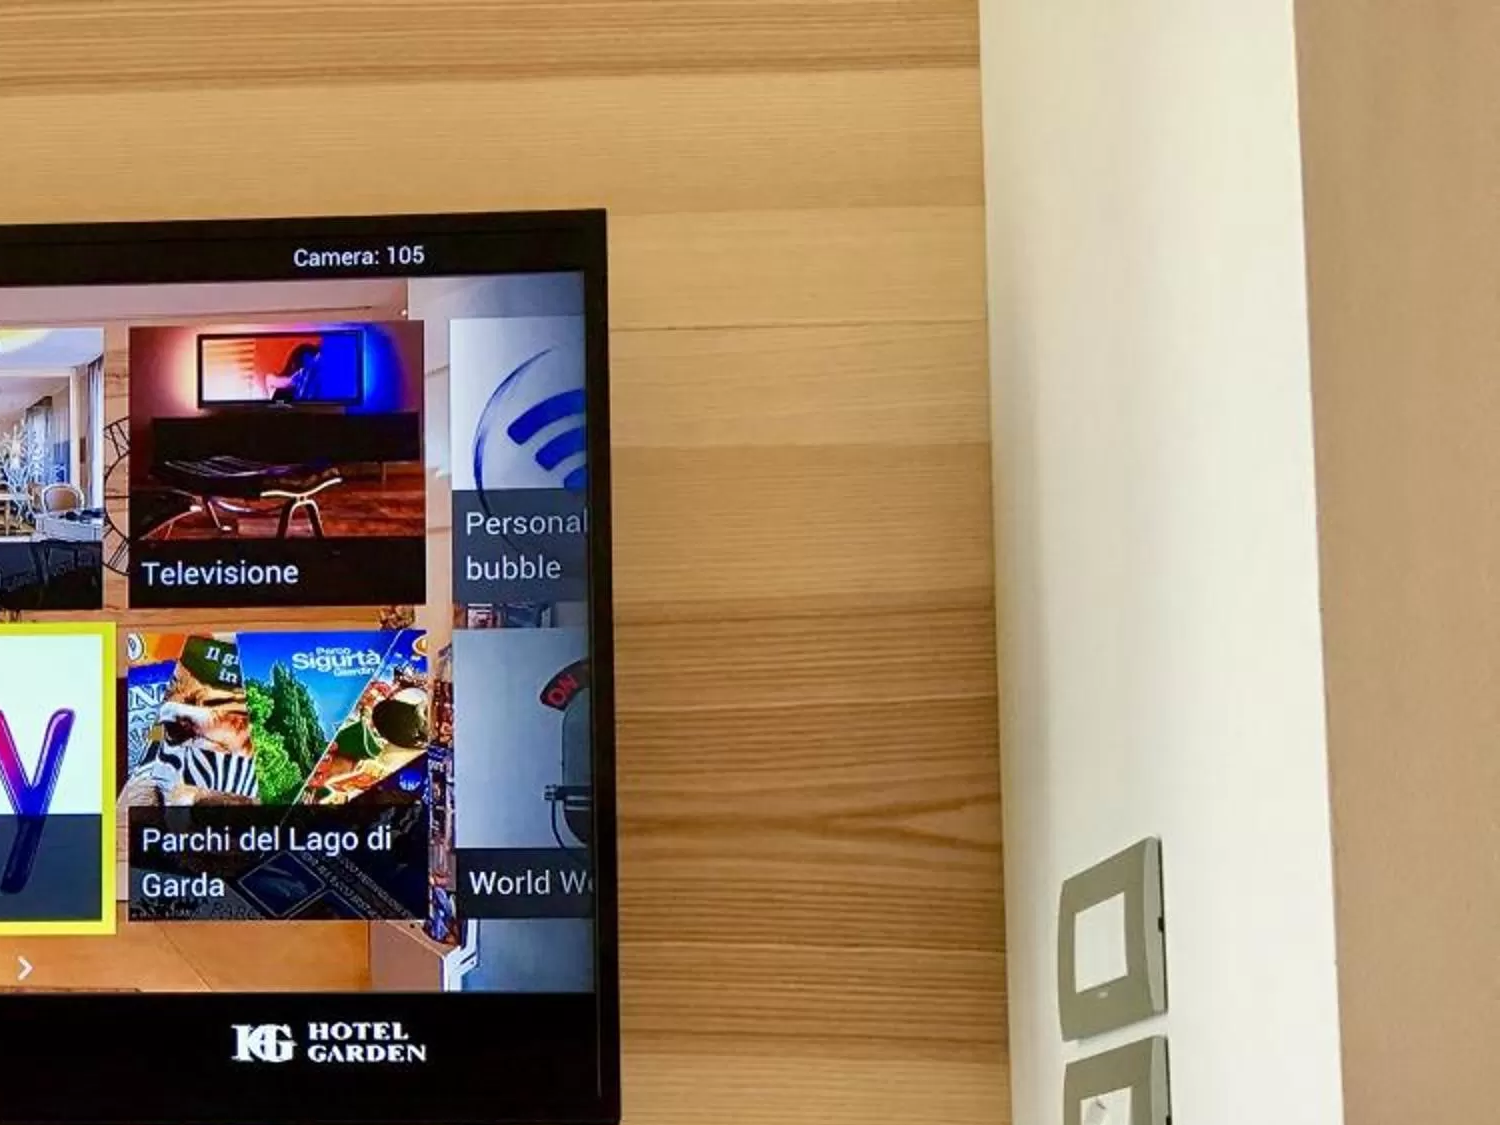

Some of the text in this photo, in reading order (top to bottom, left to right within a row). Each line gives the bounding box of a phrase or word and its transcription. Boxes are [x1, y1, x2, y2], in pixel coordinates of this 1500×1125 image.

[293, 245, 425, 267] Camera: 105
[466, 507, 588, 535] Personal
[141, 560, 300, 586] Televisione
[466, 554, 561, 580] bubble
[292, 649, 381, 672] Sigurtà
[142, 825, 392, 857] Parchi del Lago di
[142, 871, 225, 897] Garda
[469, 869, 551, 895] World
[307, 1021, 410, 1041] HOTEL
[307, 1043, 427, 1063] GARDEN
